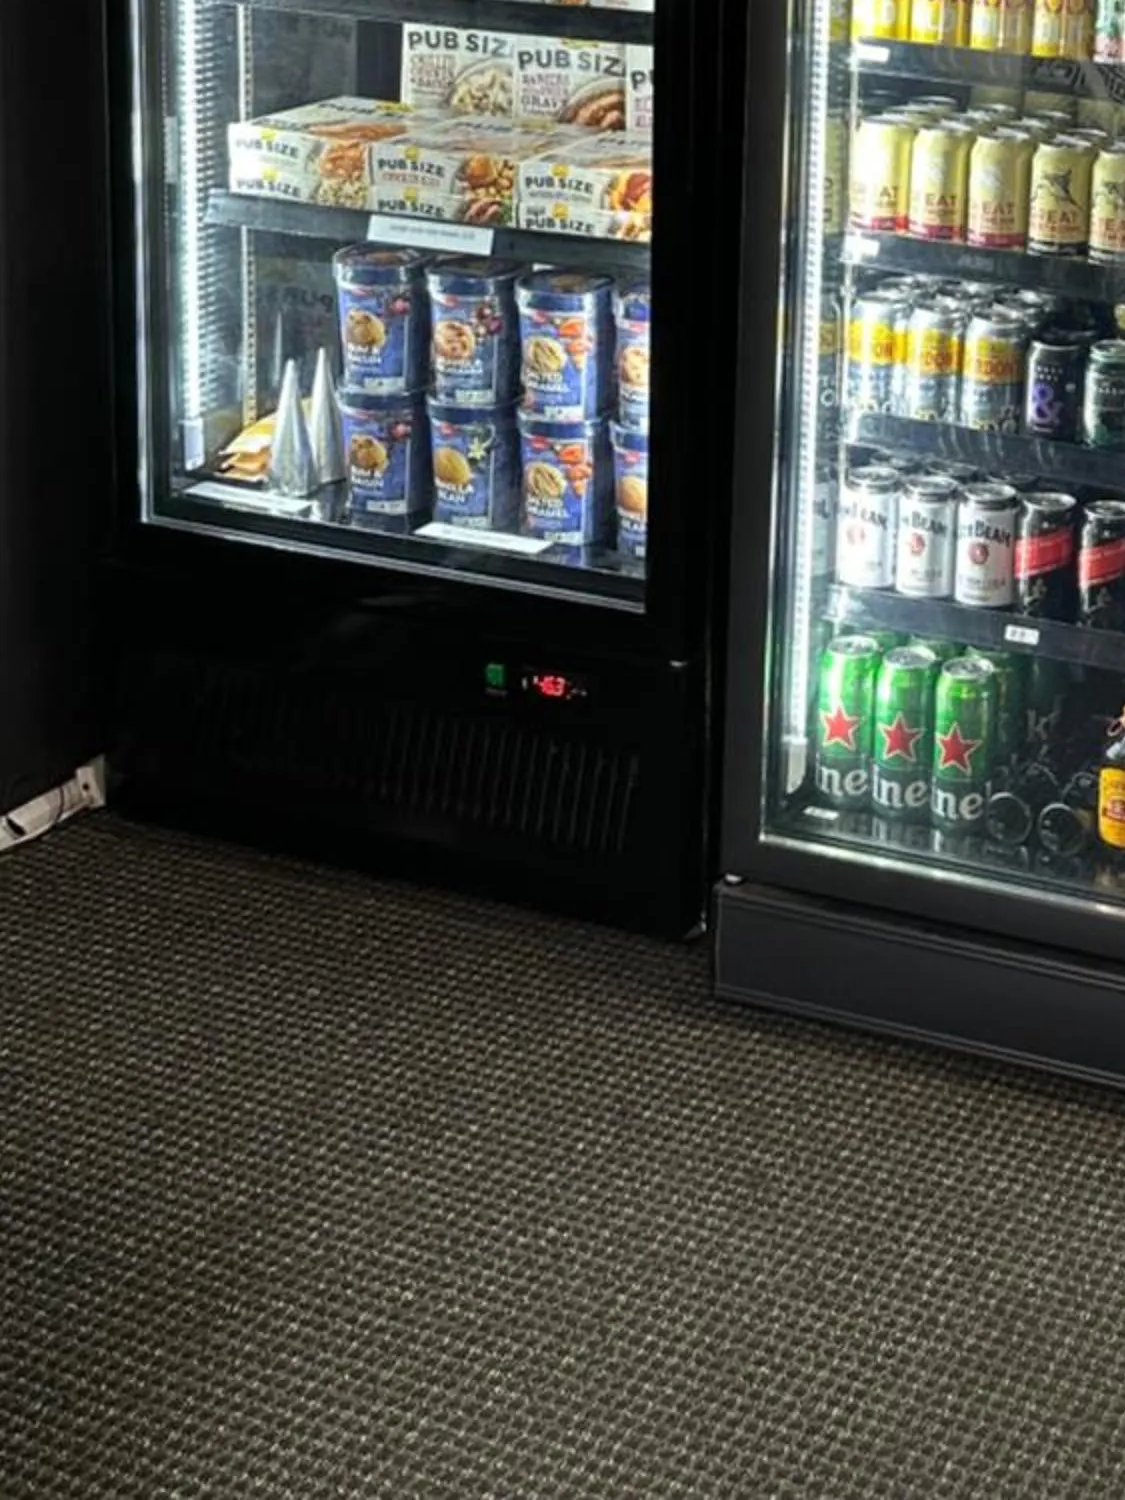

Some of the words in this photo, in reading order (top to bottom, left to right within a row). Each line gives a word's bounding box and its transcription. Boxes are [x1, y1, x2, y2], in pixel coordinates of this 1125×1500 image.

[407, 30, 459, 50] PUB
[465, 33, 513, 57] SIZ
[517, 49, 572, 71] PUB
[578, 52, 626, 77] SIZ
[377, 157, 407, 170] PUB
[410, 159, 445, 178] SIZE
[525, 175, 555, 189] PUB
[558, 175, 595, 195] SIZE
